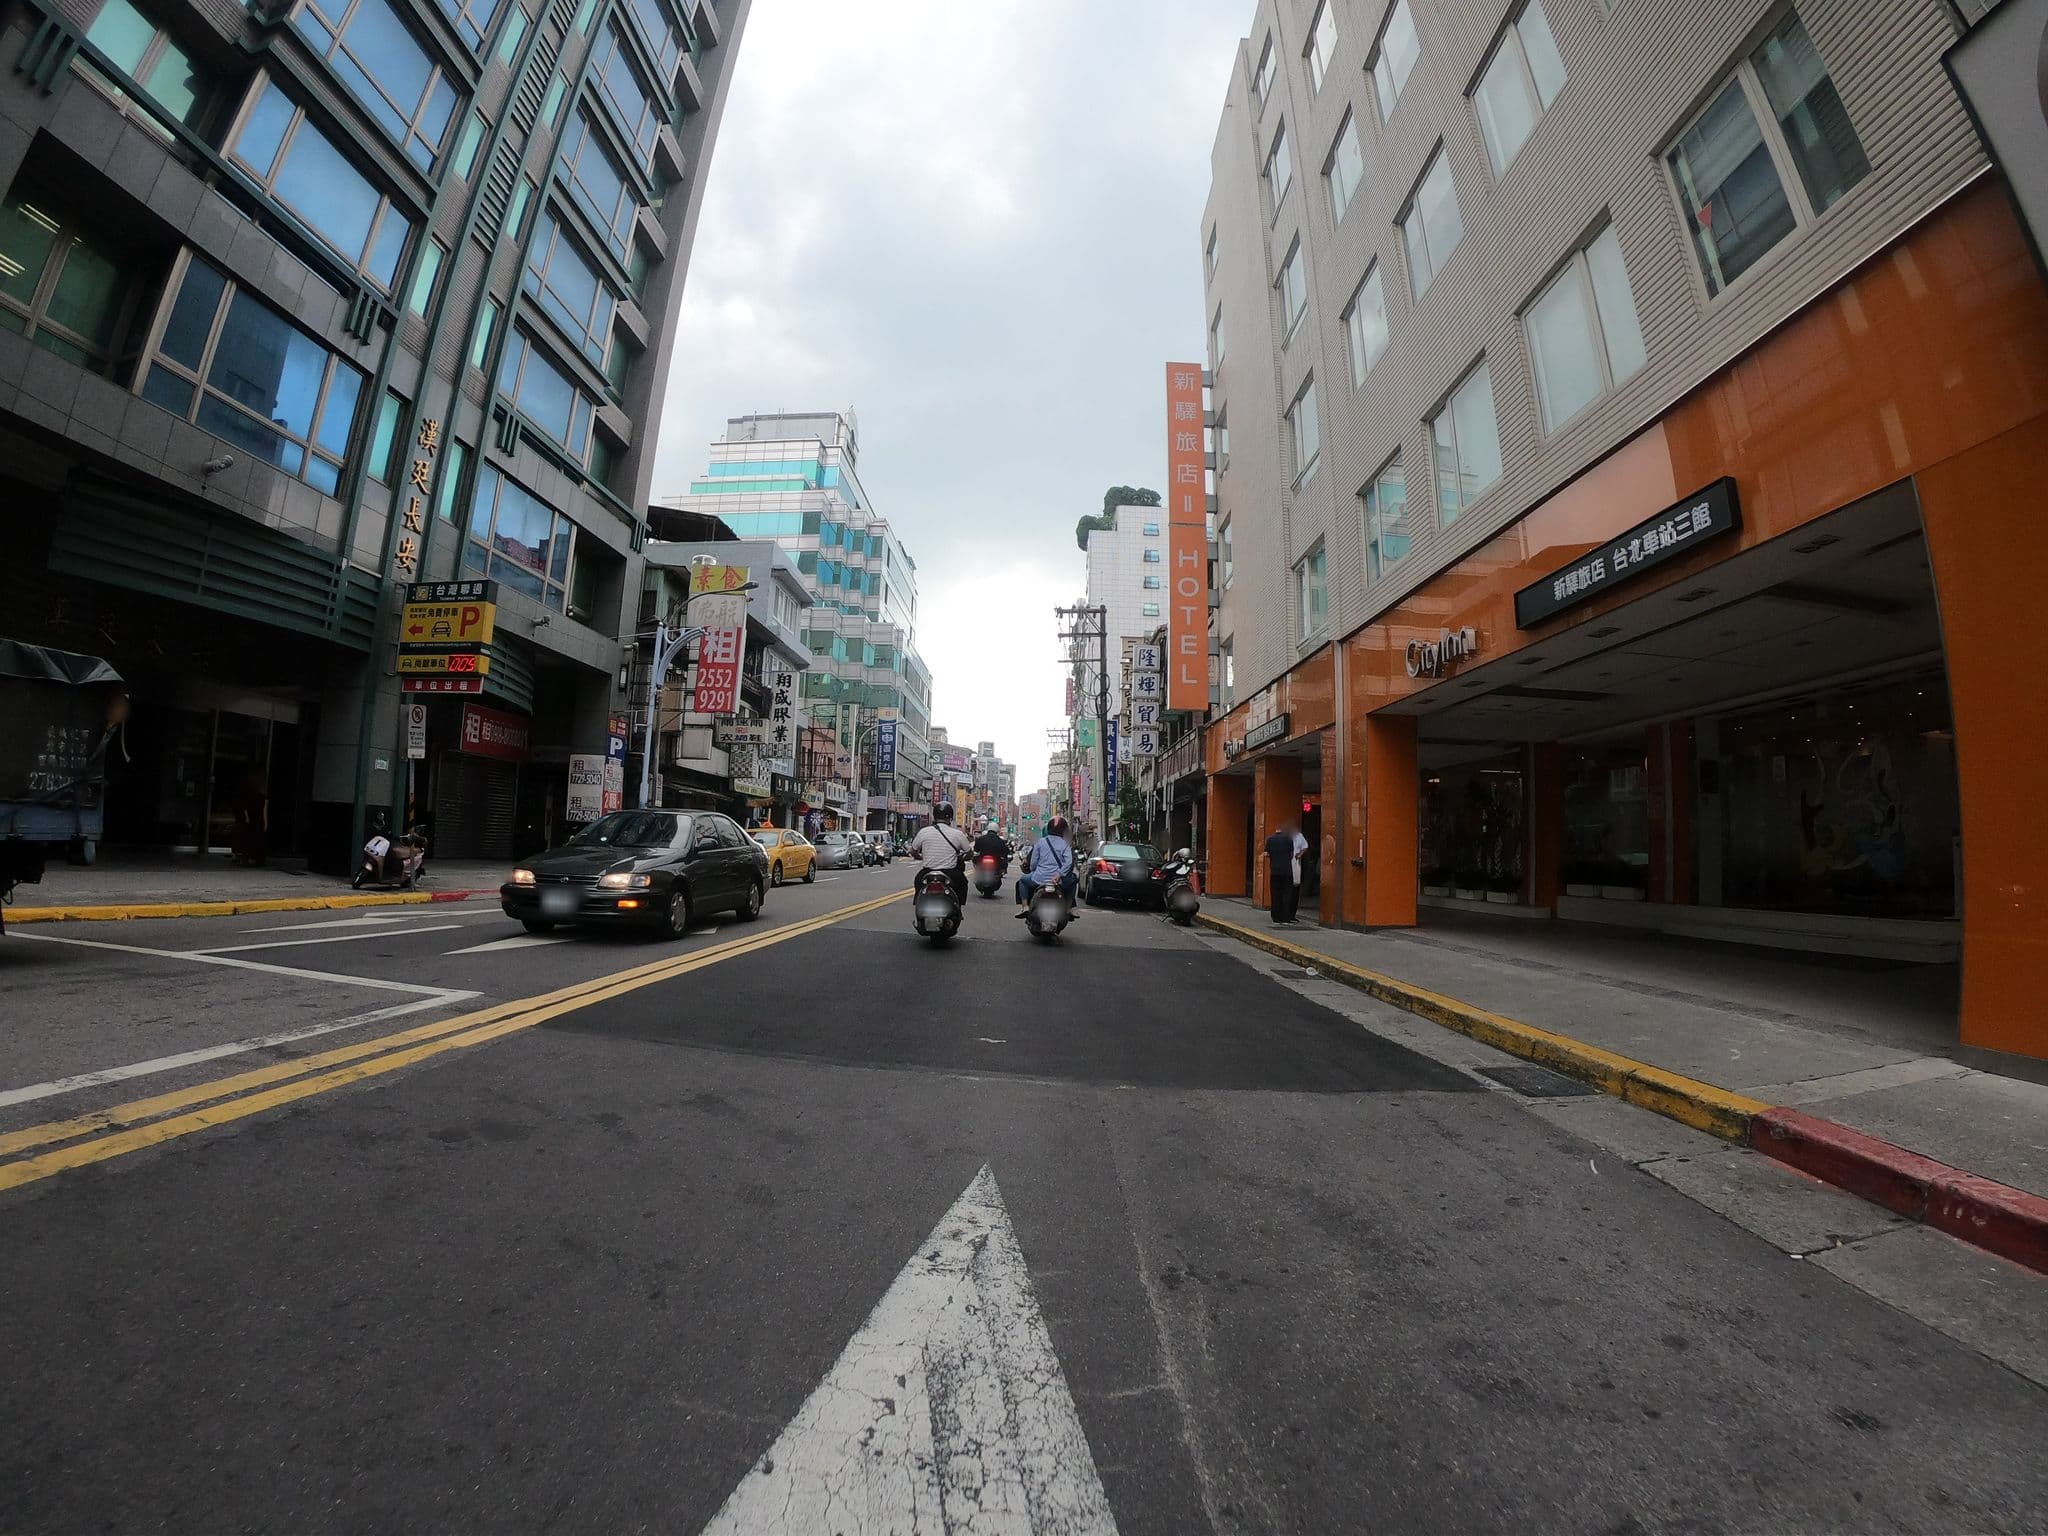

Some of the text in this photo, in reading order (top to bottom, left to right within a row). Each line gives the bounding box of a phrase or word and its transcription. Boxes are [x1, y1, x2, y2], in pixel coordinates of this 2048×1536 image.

[1612, 502, 1712, 572] 台北車站三館
[695, 566, 743, 591] 素食
[460, 606, 480, 637] P
[1177, 549, 1200, 685] HOTEL
[703, 626, 737, 663] 租
[698, 668, 732, 688] 2552
[700, 690, 732, 710] 9291
[773, 672, 792, 742] 翔盛膠業
[1137, 648, 1157, 753] 隆輝貿易
[610, 737, 623, 755] P
